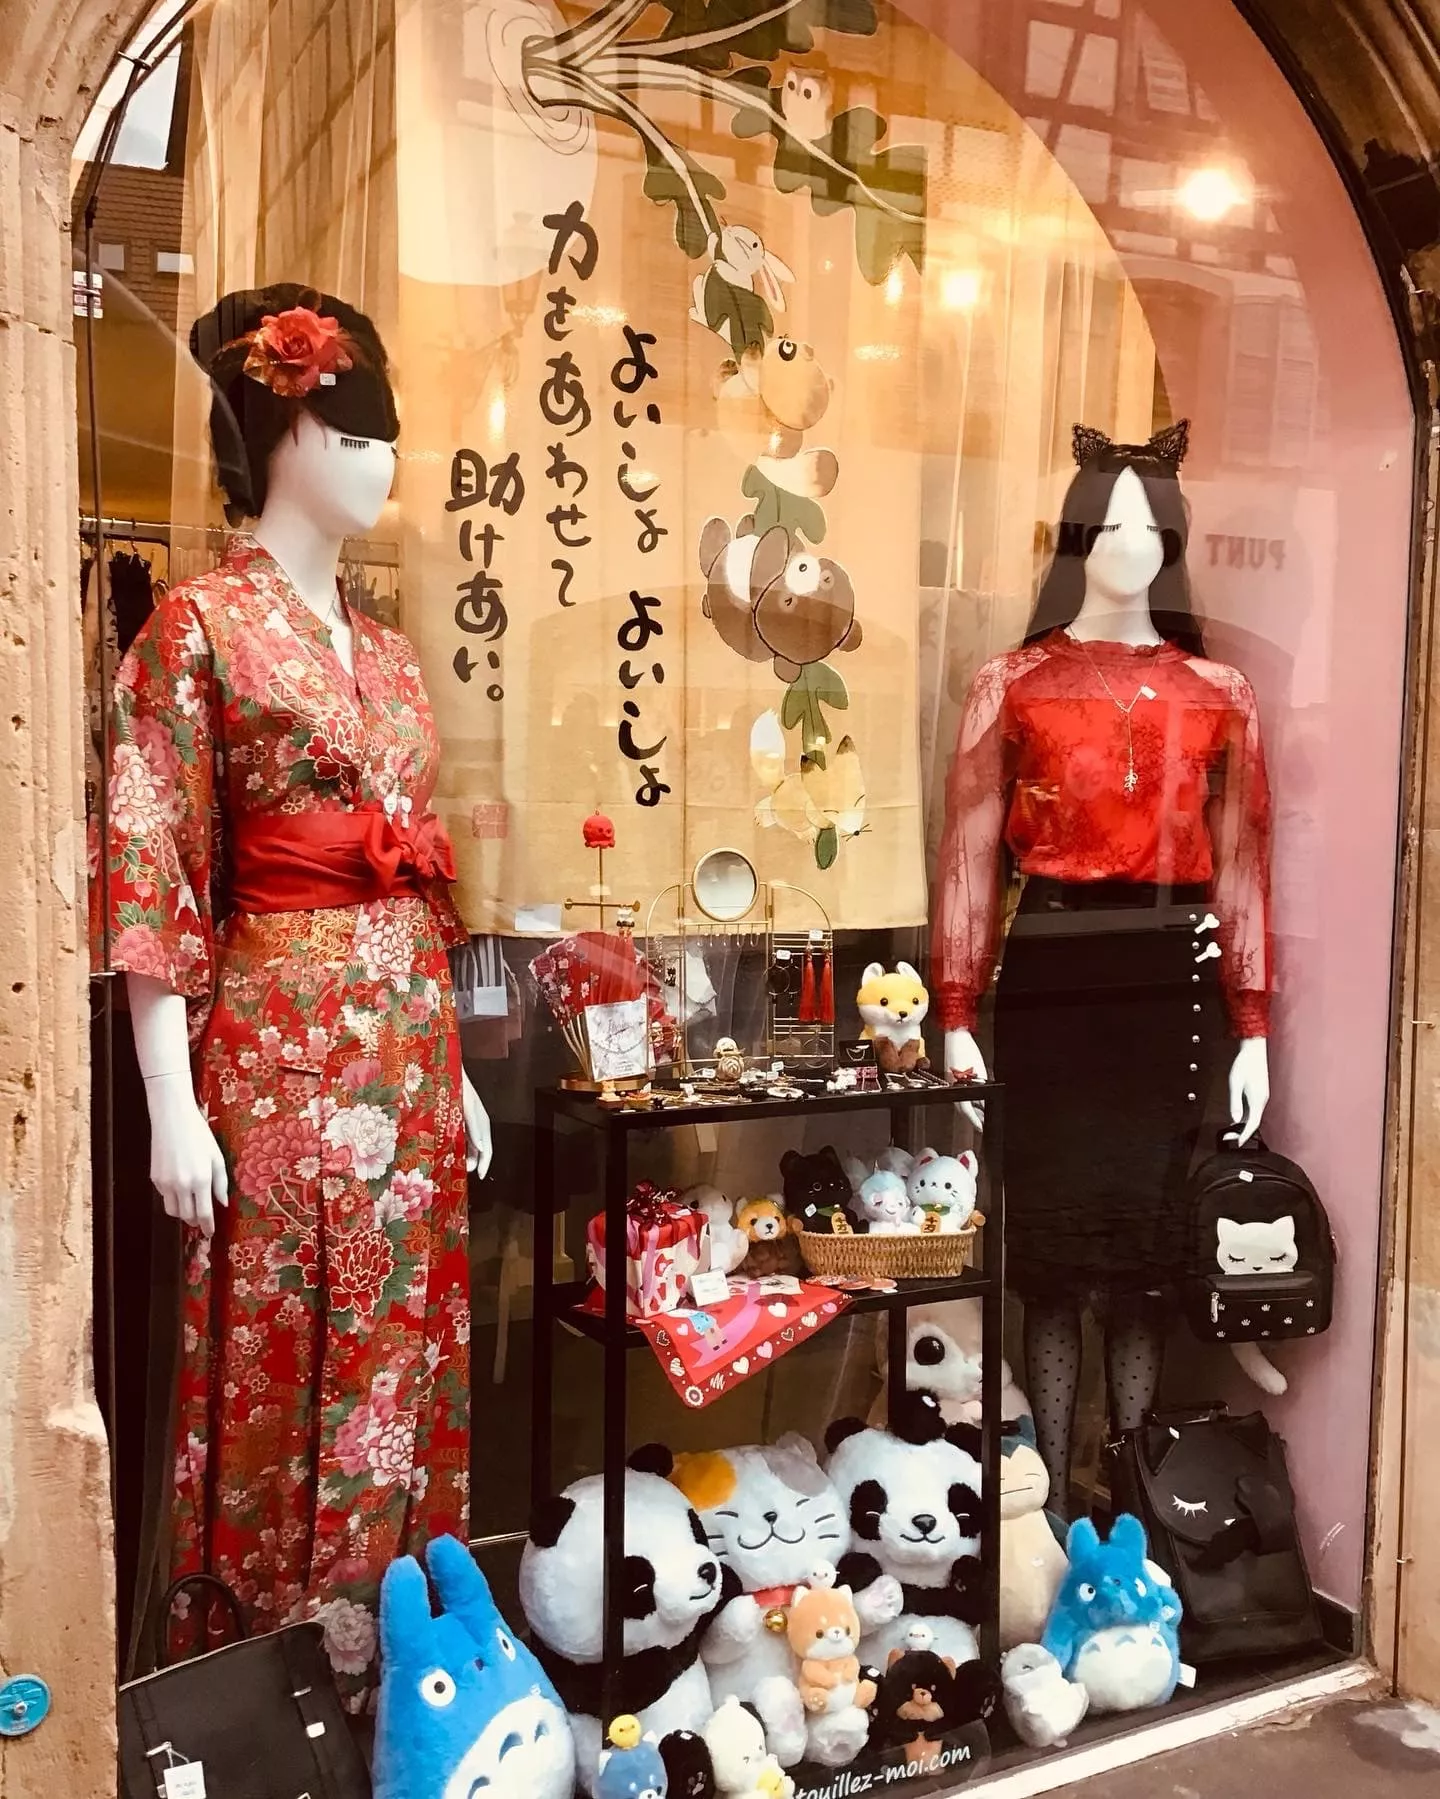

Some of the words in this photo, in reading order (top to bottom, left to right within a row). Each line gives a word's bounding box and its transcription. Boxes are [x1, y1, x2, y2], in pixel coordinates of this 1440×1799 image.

[540, 200, 599, 608] 力をあわせて
[611, 325, 669, 553] よいしょ
[445, 449, 525, 702] 助けあい。
[618, 590, 671, 807] よいしょ
[792, 1743, 972, 1799] touillez-moi.com
